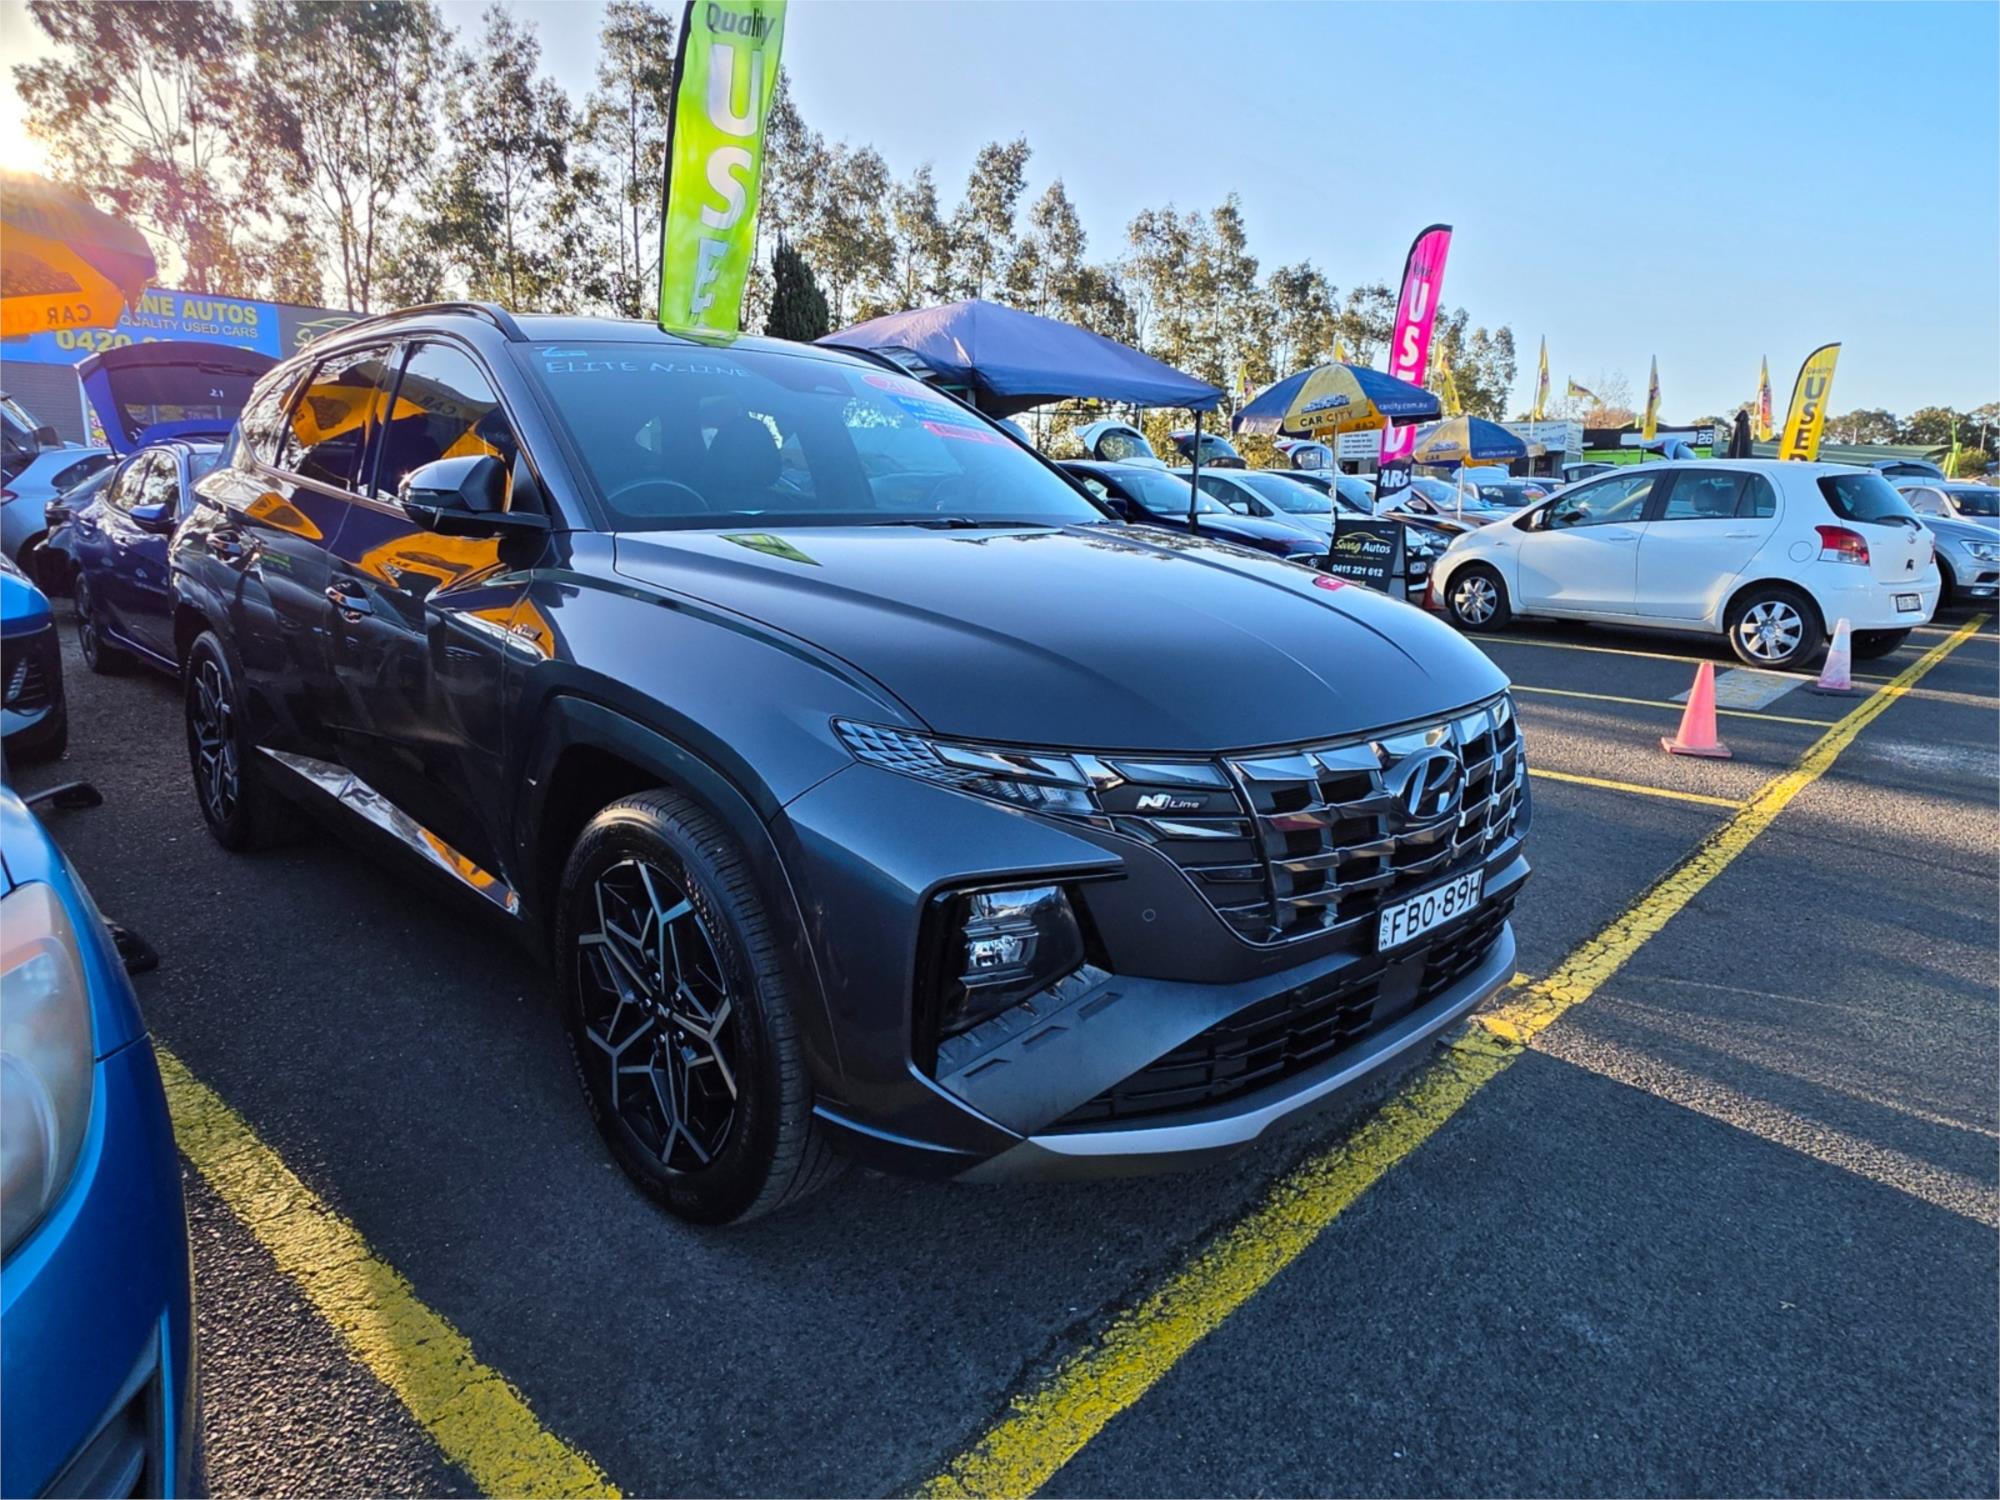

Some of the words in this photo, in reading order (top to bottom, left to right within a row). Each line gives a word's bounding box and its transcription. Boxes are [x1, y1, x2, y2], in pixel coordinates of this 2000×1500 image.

[706, 2, 775, 46] Quality
[182, 299, 258, 325] AUTOS
[183, 322, 220, 335] USED
[222, 325, 259, 338] CARS
[545, 360, 638, 374] ELITE
[1300, 416, 1323, 427] CAR
[1326, 409, 1353, 422] CITY
[1698, 433, 1713, 445] 26
[1362, 542, 1391, 554] Autos
[1352, 566, 1366, 574] 221
